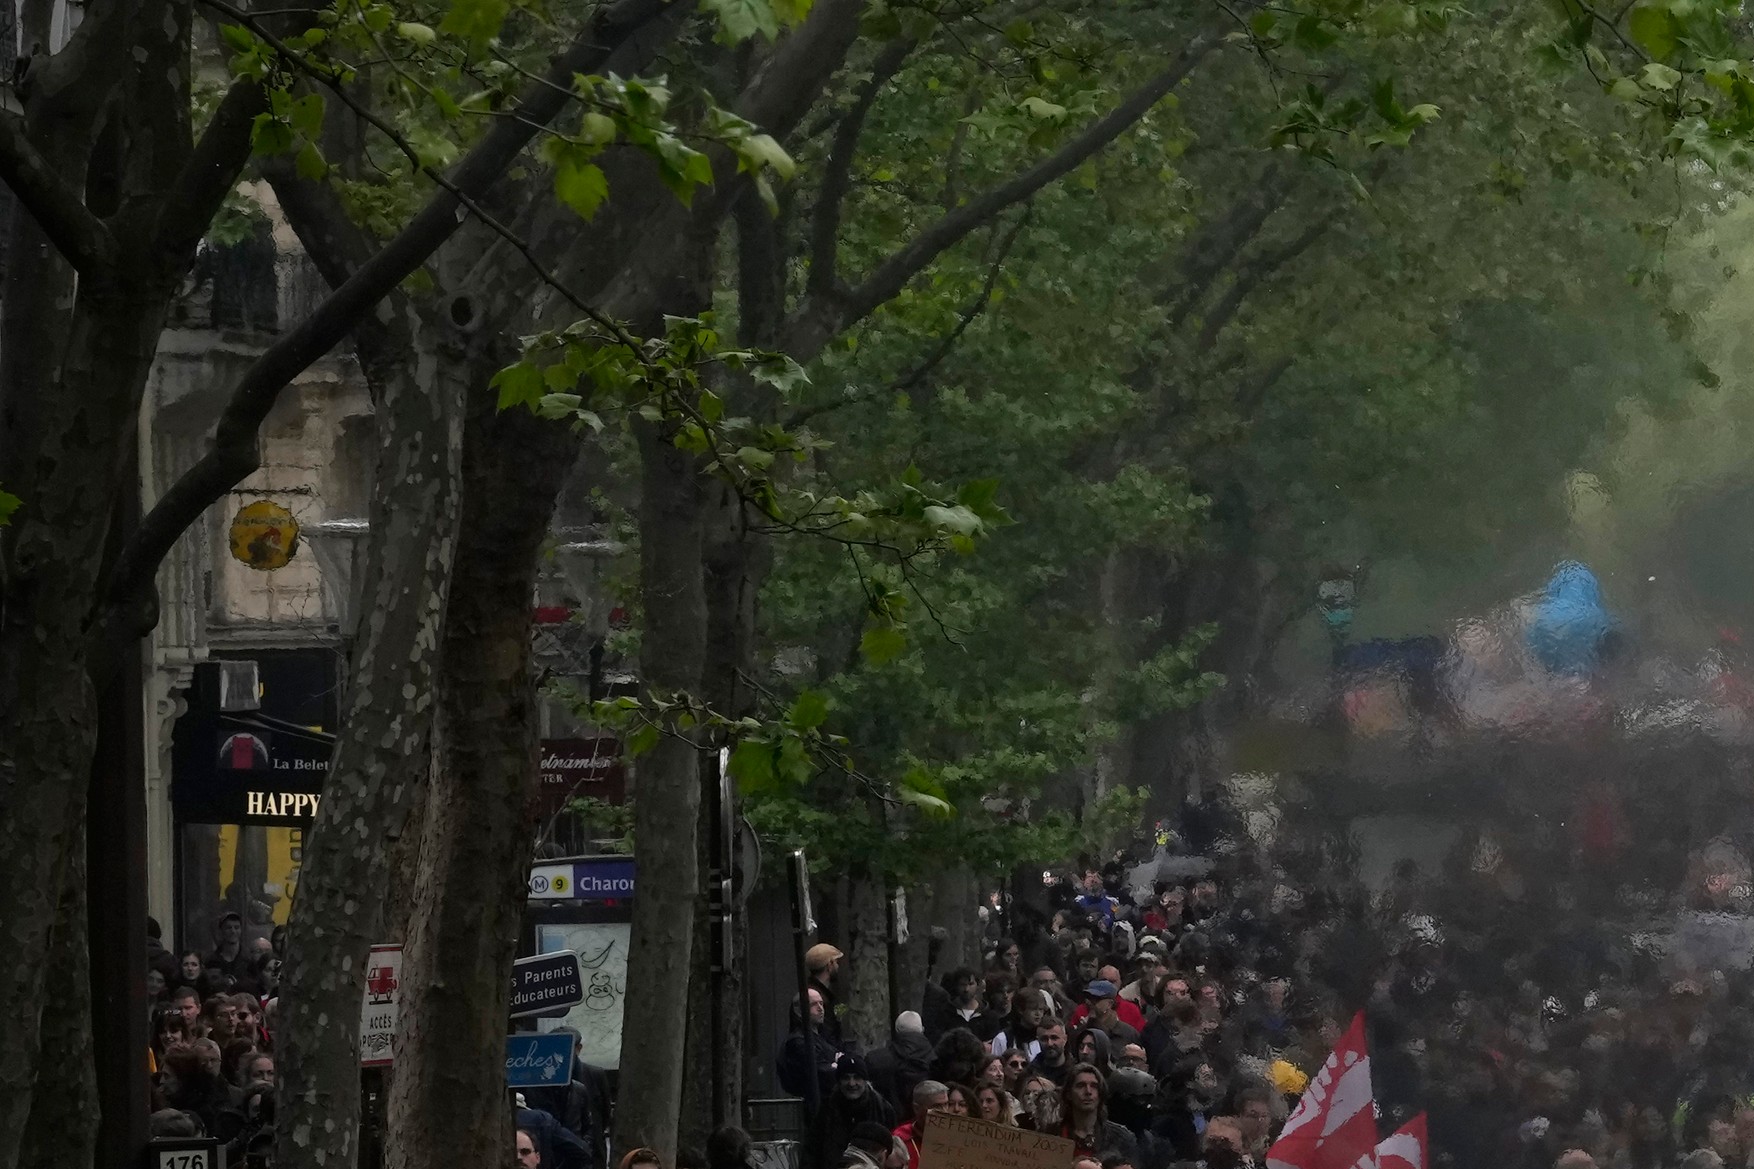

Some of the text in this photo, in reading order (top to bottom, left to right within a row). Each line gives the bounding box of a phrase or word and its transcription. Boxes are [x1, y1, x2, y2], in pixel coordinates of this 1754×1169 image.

[273, 758, 289, 770] La
[246, 791, 322, 817] HAPPY
[555, 878, 564, 890] 9
[524, 965, 573, 984] Parents
